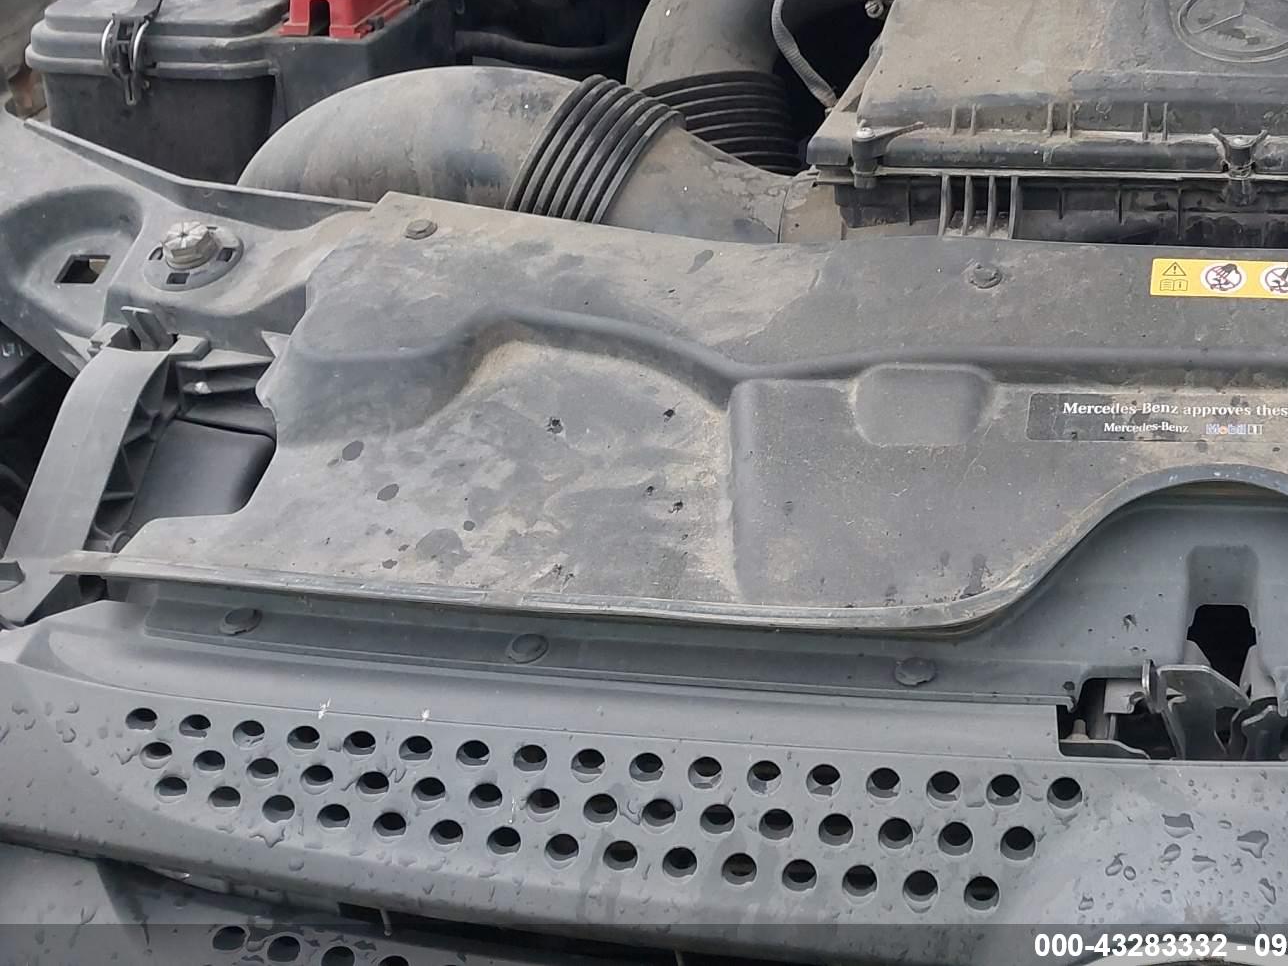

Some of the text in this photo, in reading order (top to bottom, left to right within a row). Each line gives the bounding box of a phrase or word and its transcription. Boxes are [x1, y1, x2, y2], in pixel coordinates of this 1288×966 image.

[1063, 402, 1179, 415] Mercedes-Benz
[1183, 405, 1251, 417] approves
[1104, 421, 1190, 434] Mercedes-Benz
[1206, 423, 1247, 435] Mobil
